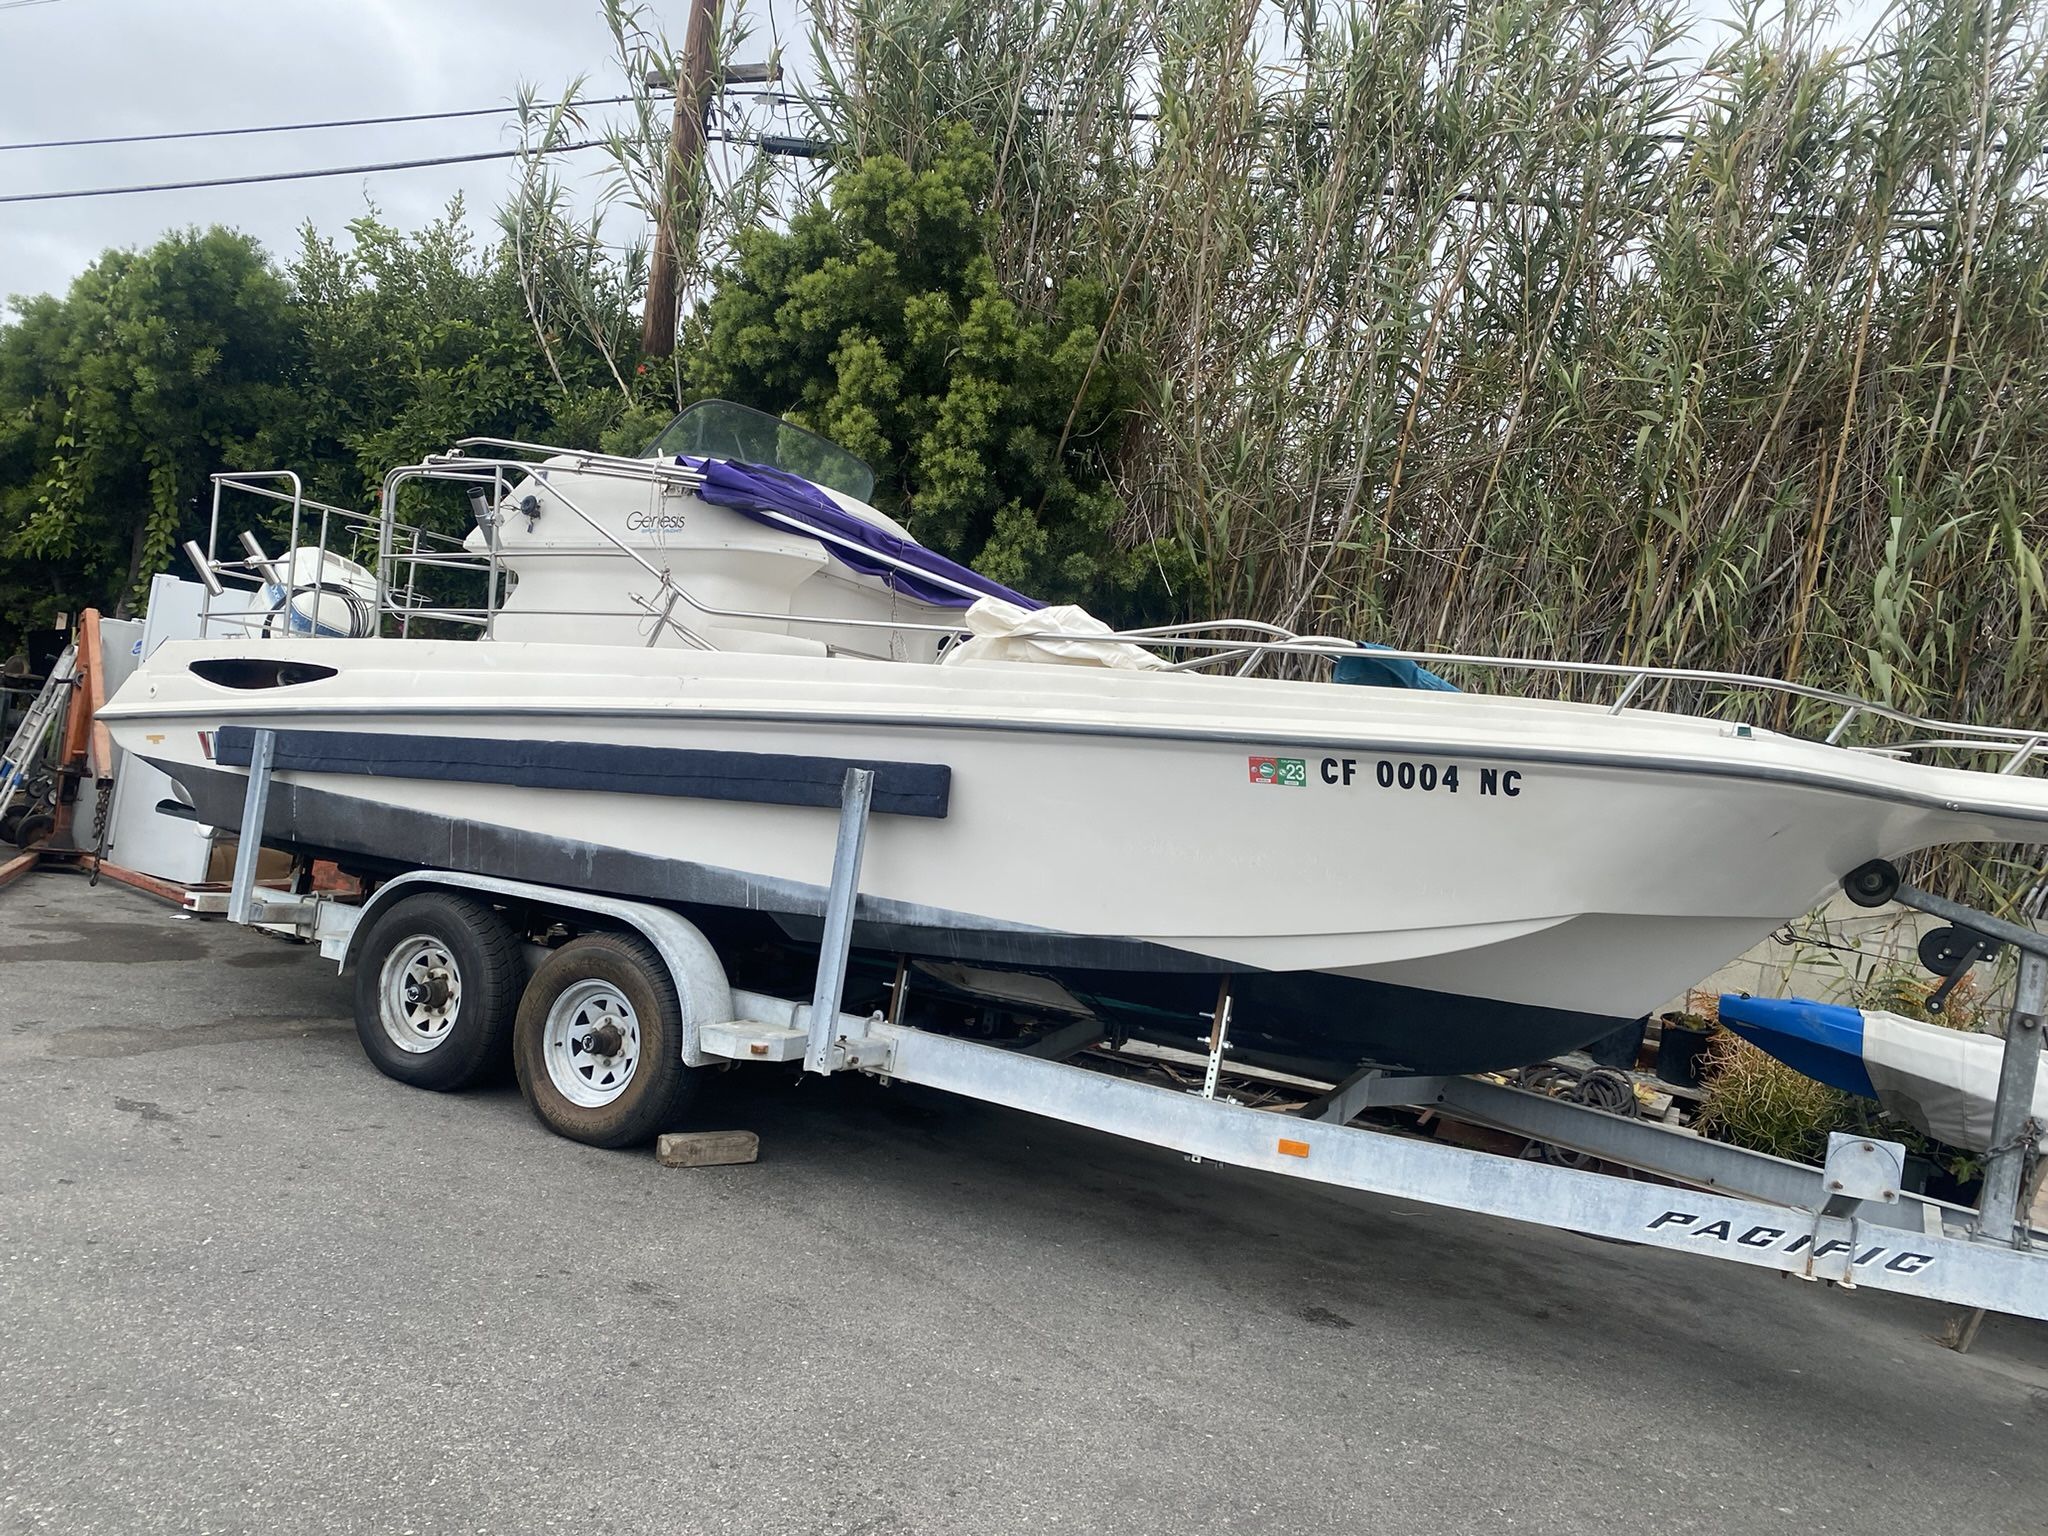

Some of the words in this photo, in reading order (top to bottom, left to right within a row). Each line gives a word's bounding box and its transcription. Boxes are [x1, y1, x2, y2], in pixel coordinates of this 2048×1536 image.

[627, 511, 686, 531] Genesis
[1286, 764, 1305, 781] 23
[1320, 758, 1357, 786] CF
[1376, 760, 1460, 793] 0004
[1480, 768, 1523, 796] NC
[1646, 1211, 1935, 1276] PACIFIC
